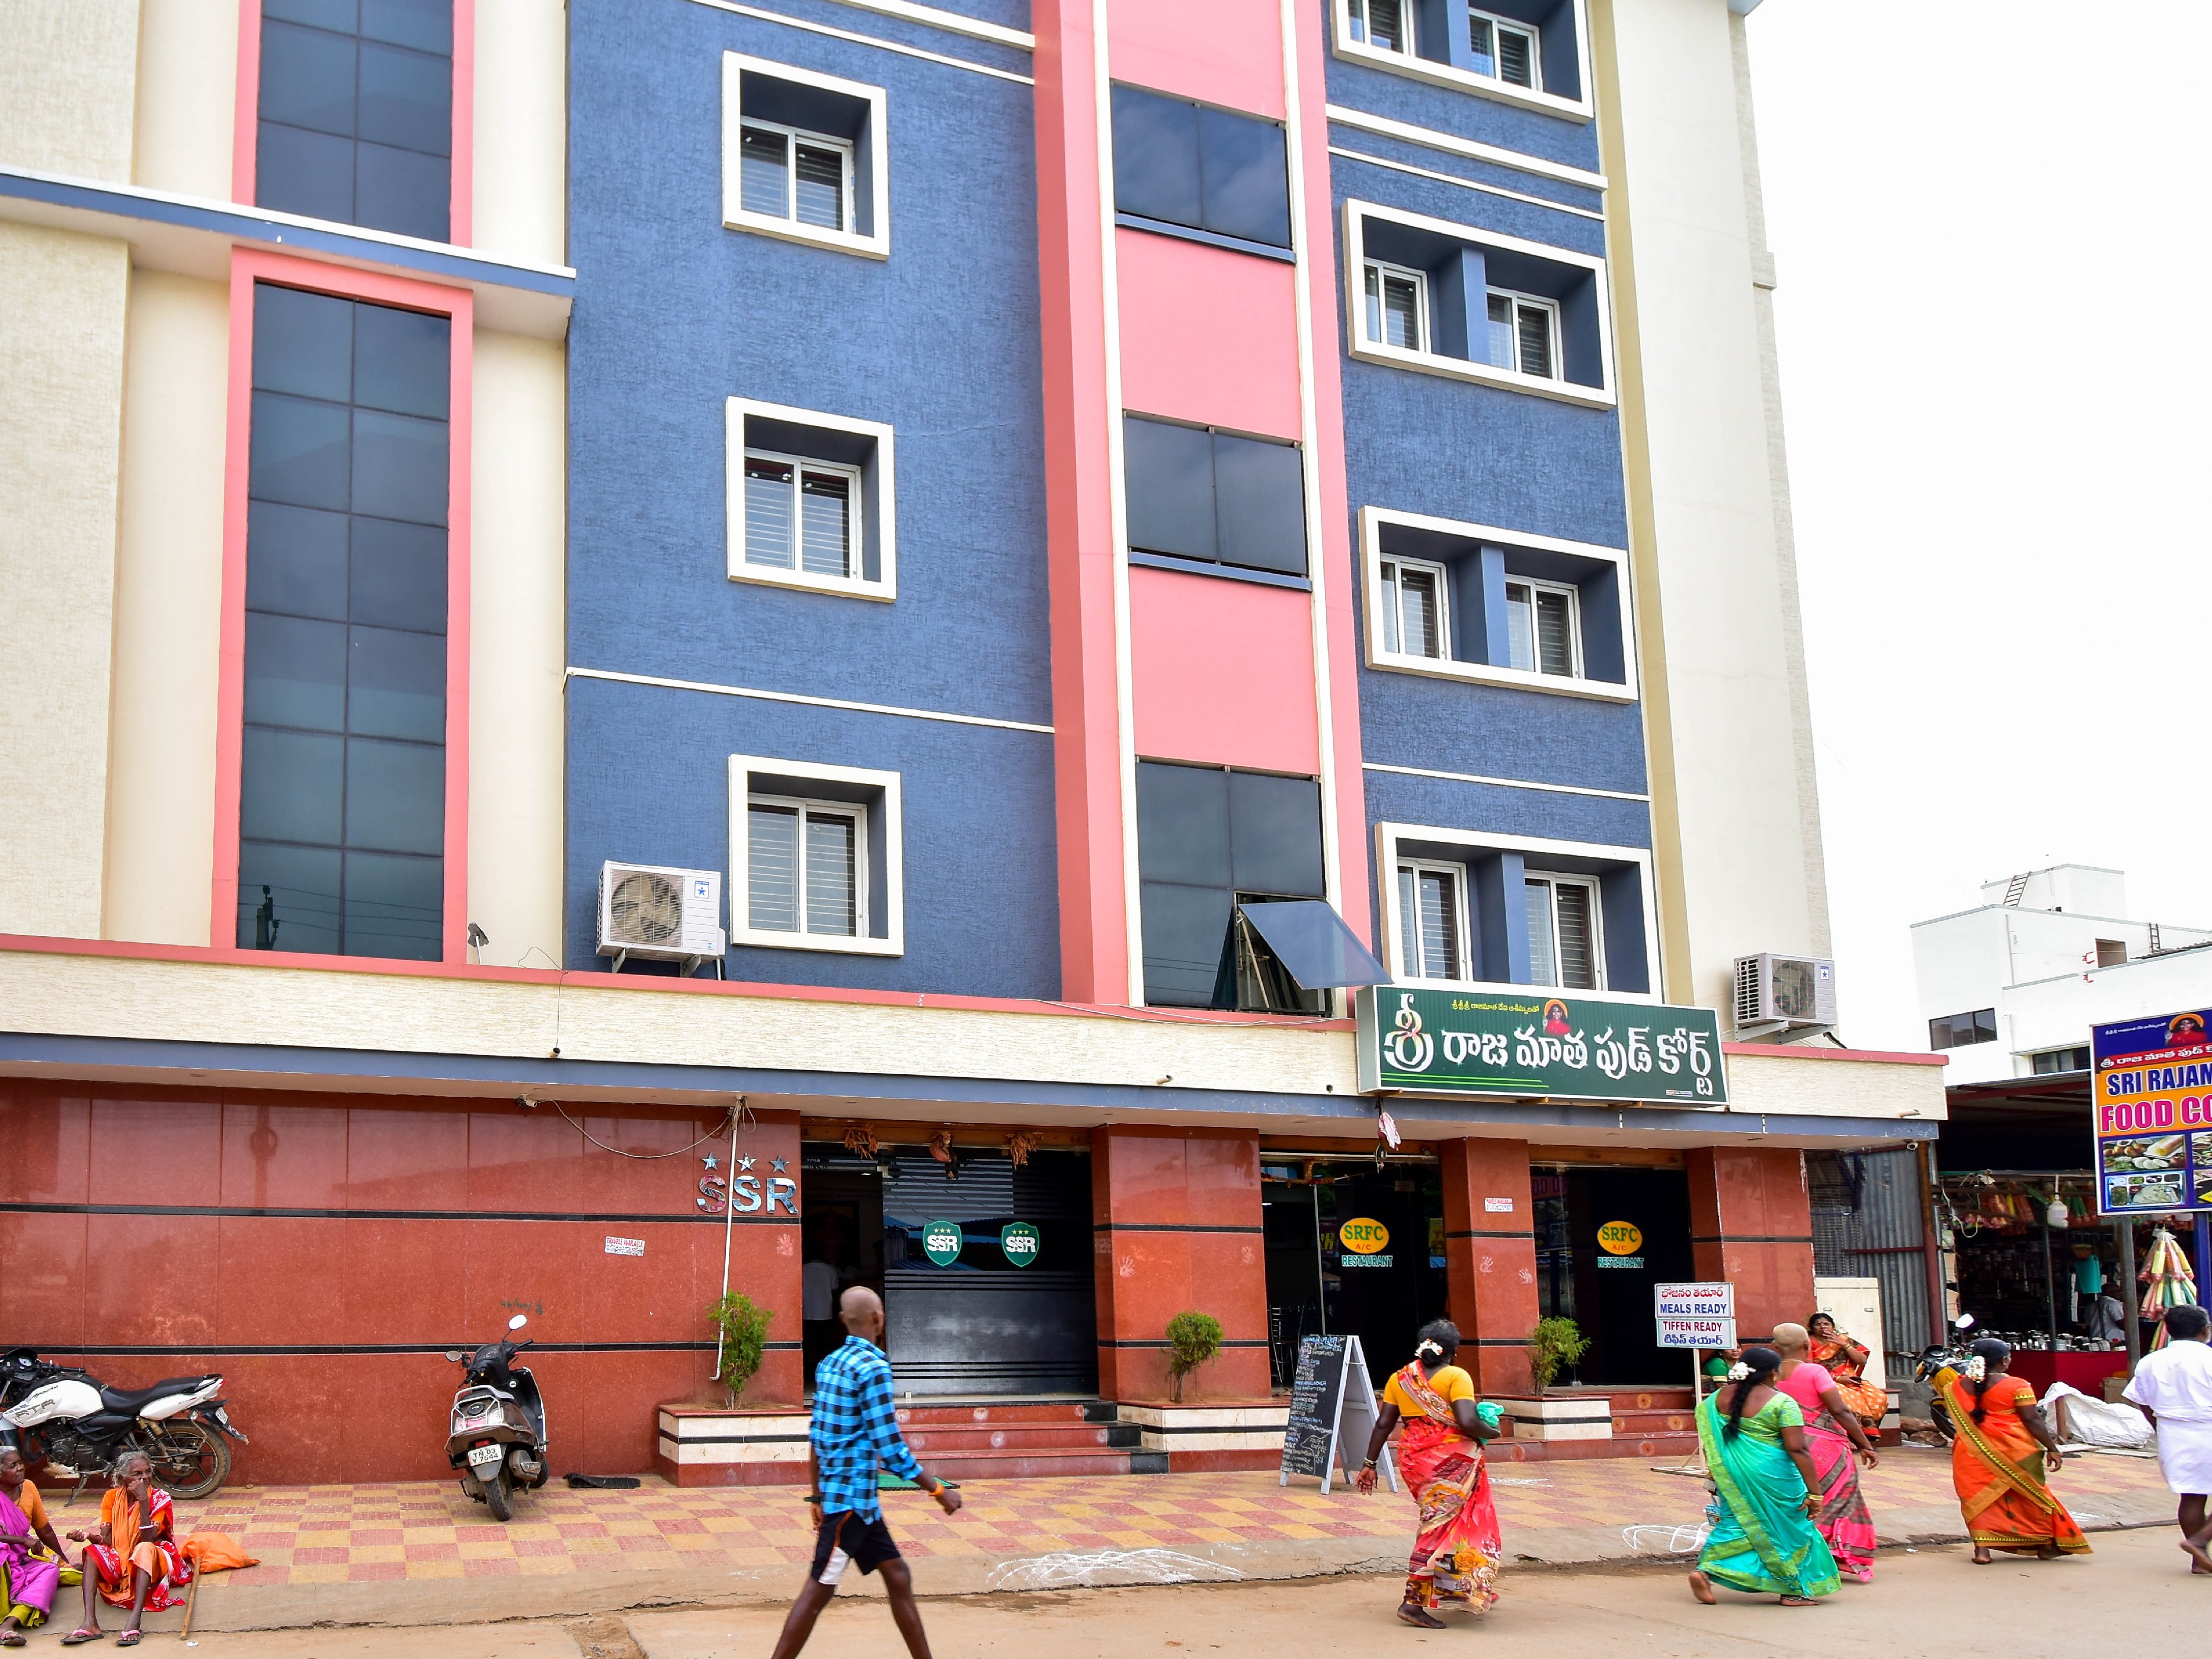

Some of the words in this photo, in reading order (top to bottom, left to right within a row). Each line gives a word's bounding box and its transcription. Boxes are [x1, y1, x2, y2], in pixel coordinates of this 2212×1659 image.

[1384, 993, 1434, 1072] శ్రీ
[2107, 1071, 2143, 1096] SRI
[2100, 1099, 2174, 1133] FOOD
[696, 1175, 799, 1214] SSR
[1344, 1225, 1384, 1241] SRFC
[1602, 1226, 1638, 1242] SRFC
[927, 1235, 958, 1252] SSR
[1006, 1236, 1036, 1253] SSR
[1342, 1255, 1392, 1267] RESTAURANT
[1597, 1257, 1644, 1269] RESTAURANT
[1660, 1304, 1692, 1314] MEALS
[1694, 1304, 1727, 1314] READY
[1663, 1321, 1691, 1331] TIFFEN
[1694, 1322, 1722, 1332] READY
